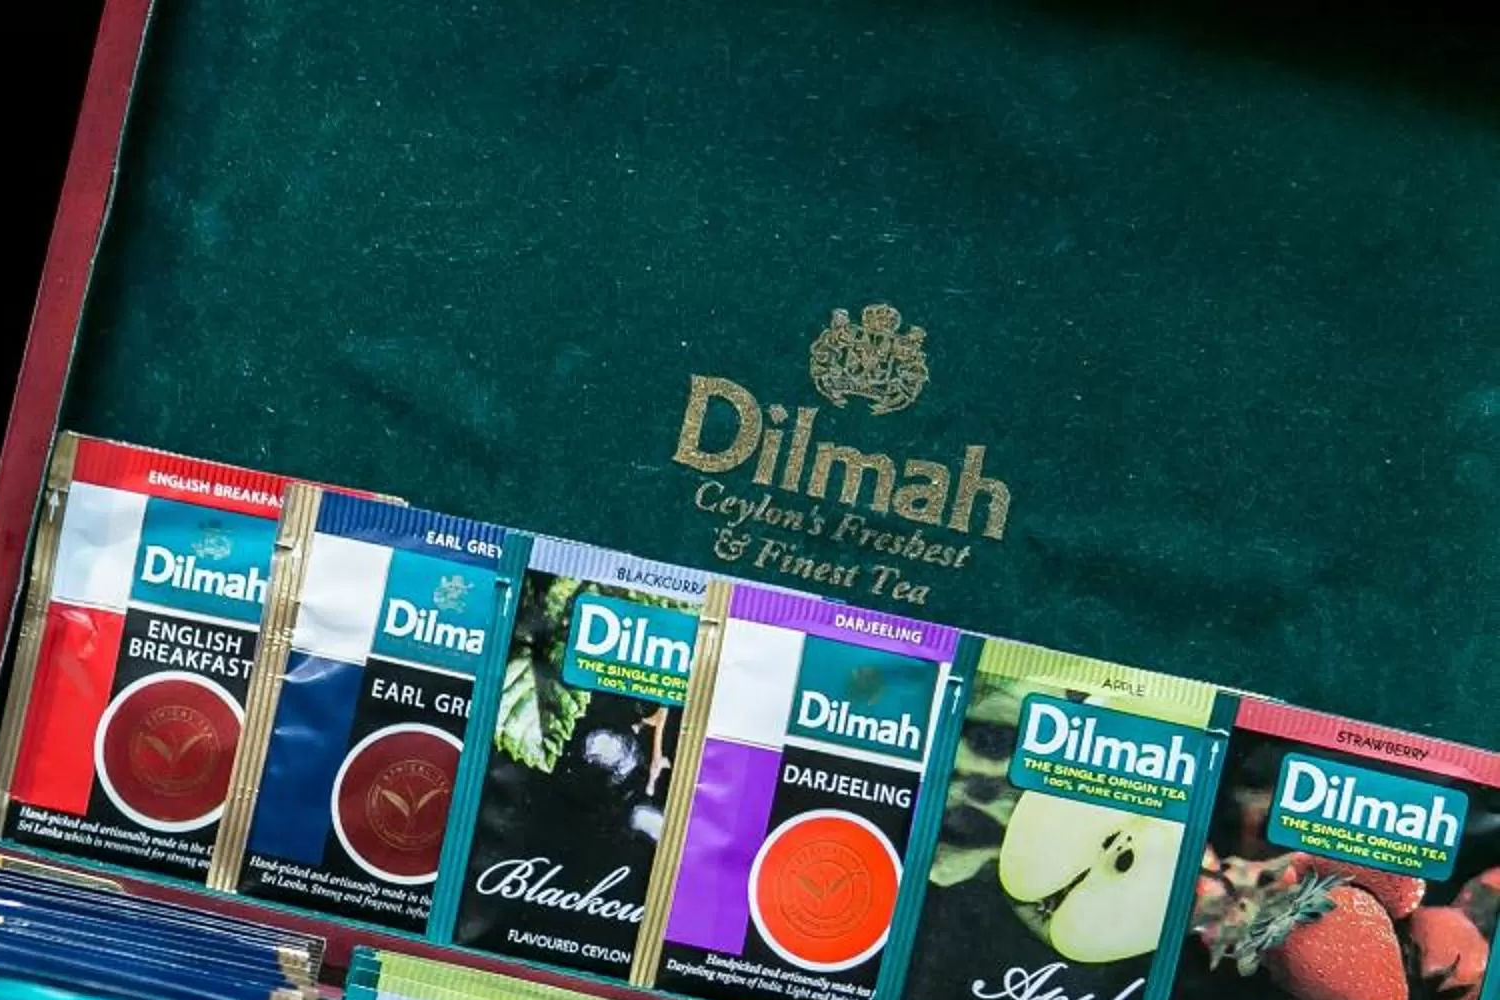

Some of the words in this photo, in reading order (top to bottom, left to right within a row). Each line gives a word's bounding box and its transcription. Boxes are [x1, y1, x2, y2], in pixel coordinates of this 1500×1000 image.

[672, 374, 1011, 541] Dilmah
[148, 470, 210, 493] ENGLISH
[214, 483, 284, 508] BREAKFAS
[426, 531, 464, 551] EARL
[467, 539, 503, 559] GREY
[695, 480, 825, 538] Ceylon's
[830, 513, 970, 569] Freshest
[140, 545, 269, 604] Dilmah
[616, 567, 707, 595] BLACKCURR
[713, 527, 750, 561] &
[753, 536, 860, 588] Finest
[871, 564, 931, 606] Tea
[147, 619, 243, 655] ENGLISH
[383, 598, 485, 656] Dilma
[573, 603, 691, 674] Dilm
[835, 614, 922, 644] DARJEELING
[129, 638, 254, 679] BREAKFAST
[577, 658, 605, 673] THE
[607, 665, 658, 684] SINGLE
[661, 675, 688, 689] ORI
[371, 678, 425, 709] EARL
[434, 693, 473, 718] GR
[597, 676, 626, 692] 100%
[631, 683, 666, 697] PURE
[1101, 678, 1146, 697] APPLE
[796, 689, 921, 750] Dilmah
[1022, 702, 1196, 785] Dilmah
[1336, 730, 1429, 761] STRAWBERRY
[783, 764, 912, 808] DARJEELING
[1024, 757, 1052, 773] THE
[1053, 763, 1106, 784] SINGLE
[1108, 775, 1158, 795] ORIGIN
[1160, 786, 1187, 801] TEA
[1043, 775, 1073, 791] 100%
[1077, 783, 1111, 798] PURE
[1112, 790, 1163, 808] CEYLON
[1279, 759, 1459, 847] Dilmah
[17, 819, 34, 832] Sri
[197, 859, 212, 869] an
[1281, 815, 1310, 831] THE
[1311, 822, 1365, 843] SINGLE
[1367, 835, 1418, 855] ORIGIN
[1421, 847, 1447, 861] TEA
[1301, 834, 1331, 850] 100%
[1336, 842, 1370, 857] PURE
[1372, 850, 1422, 868] CEYLON
[261, 871, 277, 885] Sri
[476, 857, 646, 924] Blackcu
[507, 929, 579, 954] FLAVOURED
[581, 943, 632, 964] CEYLON
